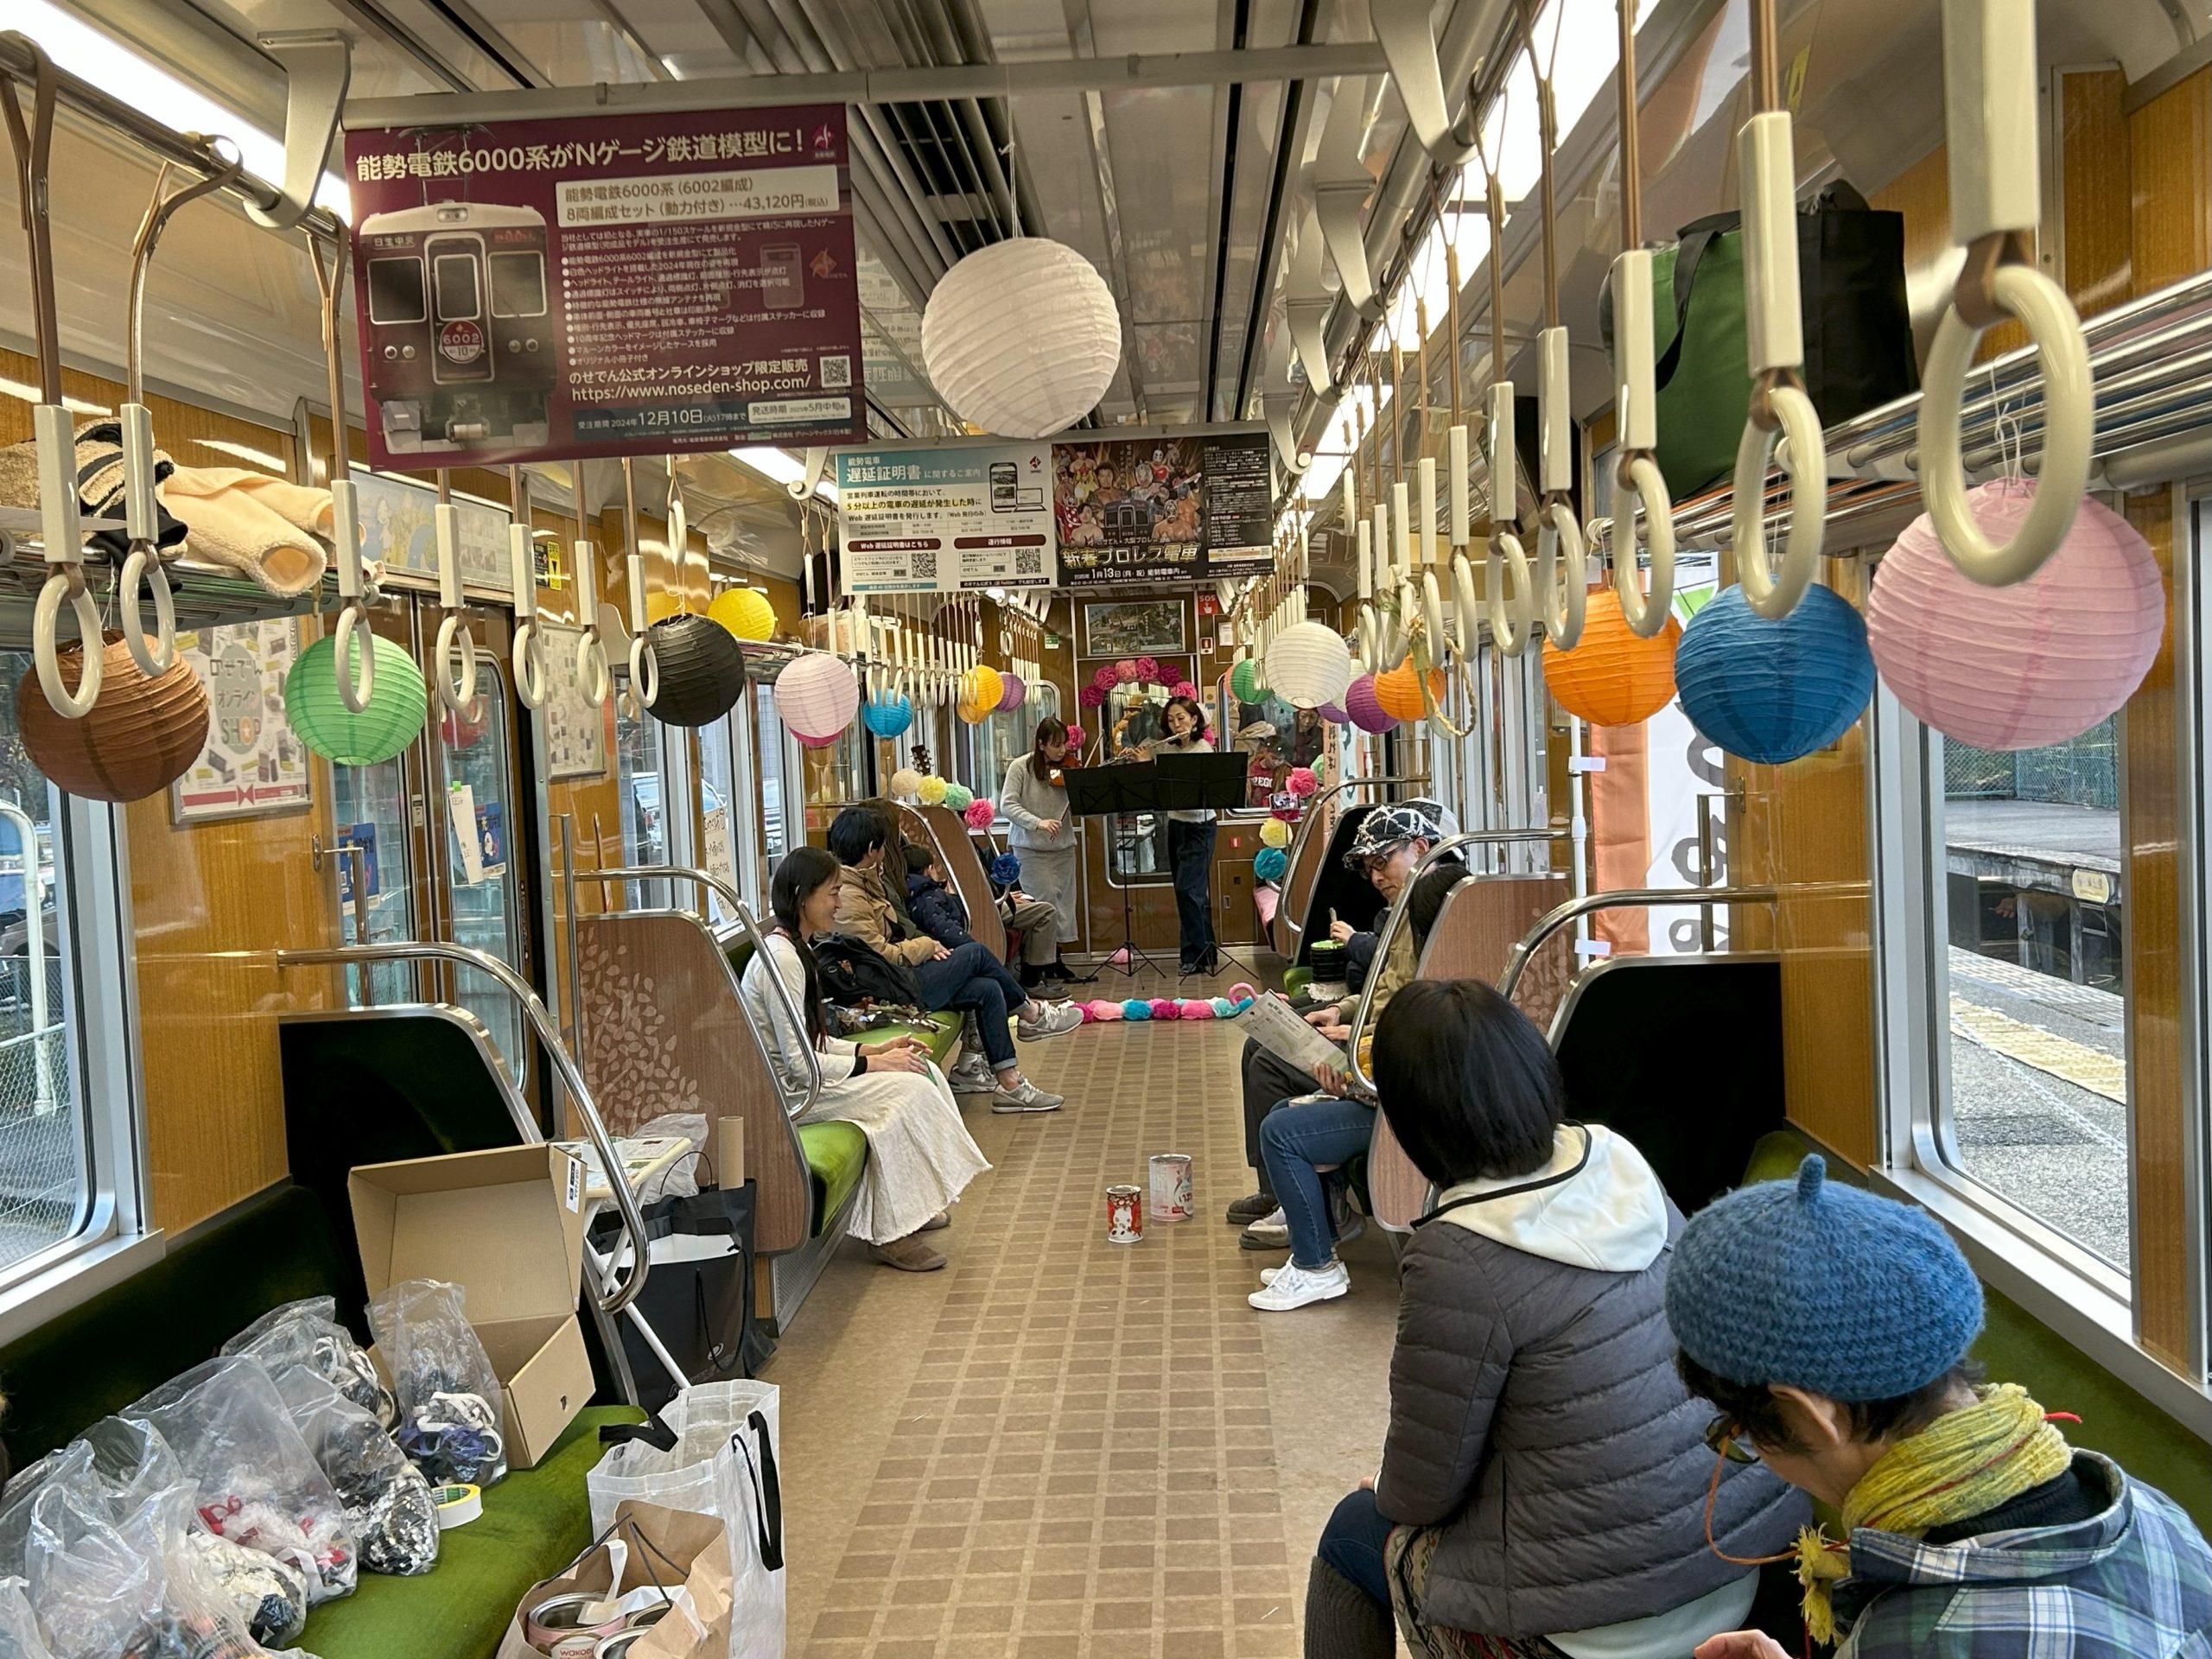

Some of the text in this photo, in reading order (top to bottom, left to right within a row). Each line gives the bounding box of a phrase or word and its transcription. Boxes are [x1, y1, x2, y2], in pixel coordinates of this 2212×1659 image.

[443, 334, 480, 345] 6002
[569, 359, 809, 385] のせでん公式オンラインショップ限定販売
[571, 375, 812, 403] https://www.noseden-shop.com/
[847, 464, 922, 483] 遅延証明書
[1063, 543, 1200, 569] 新春プロレス電車
